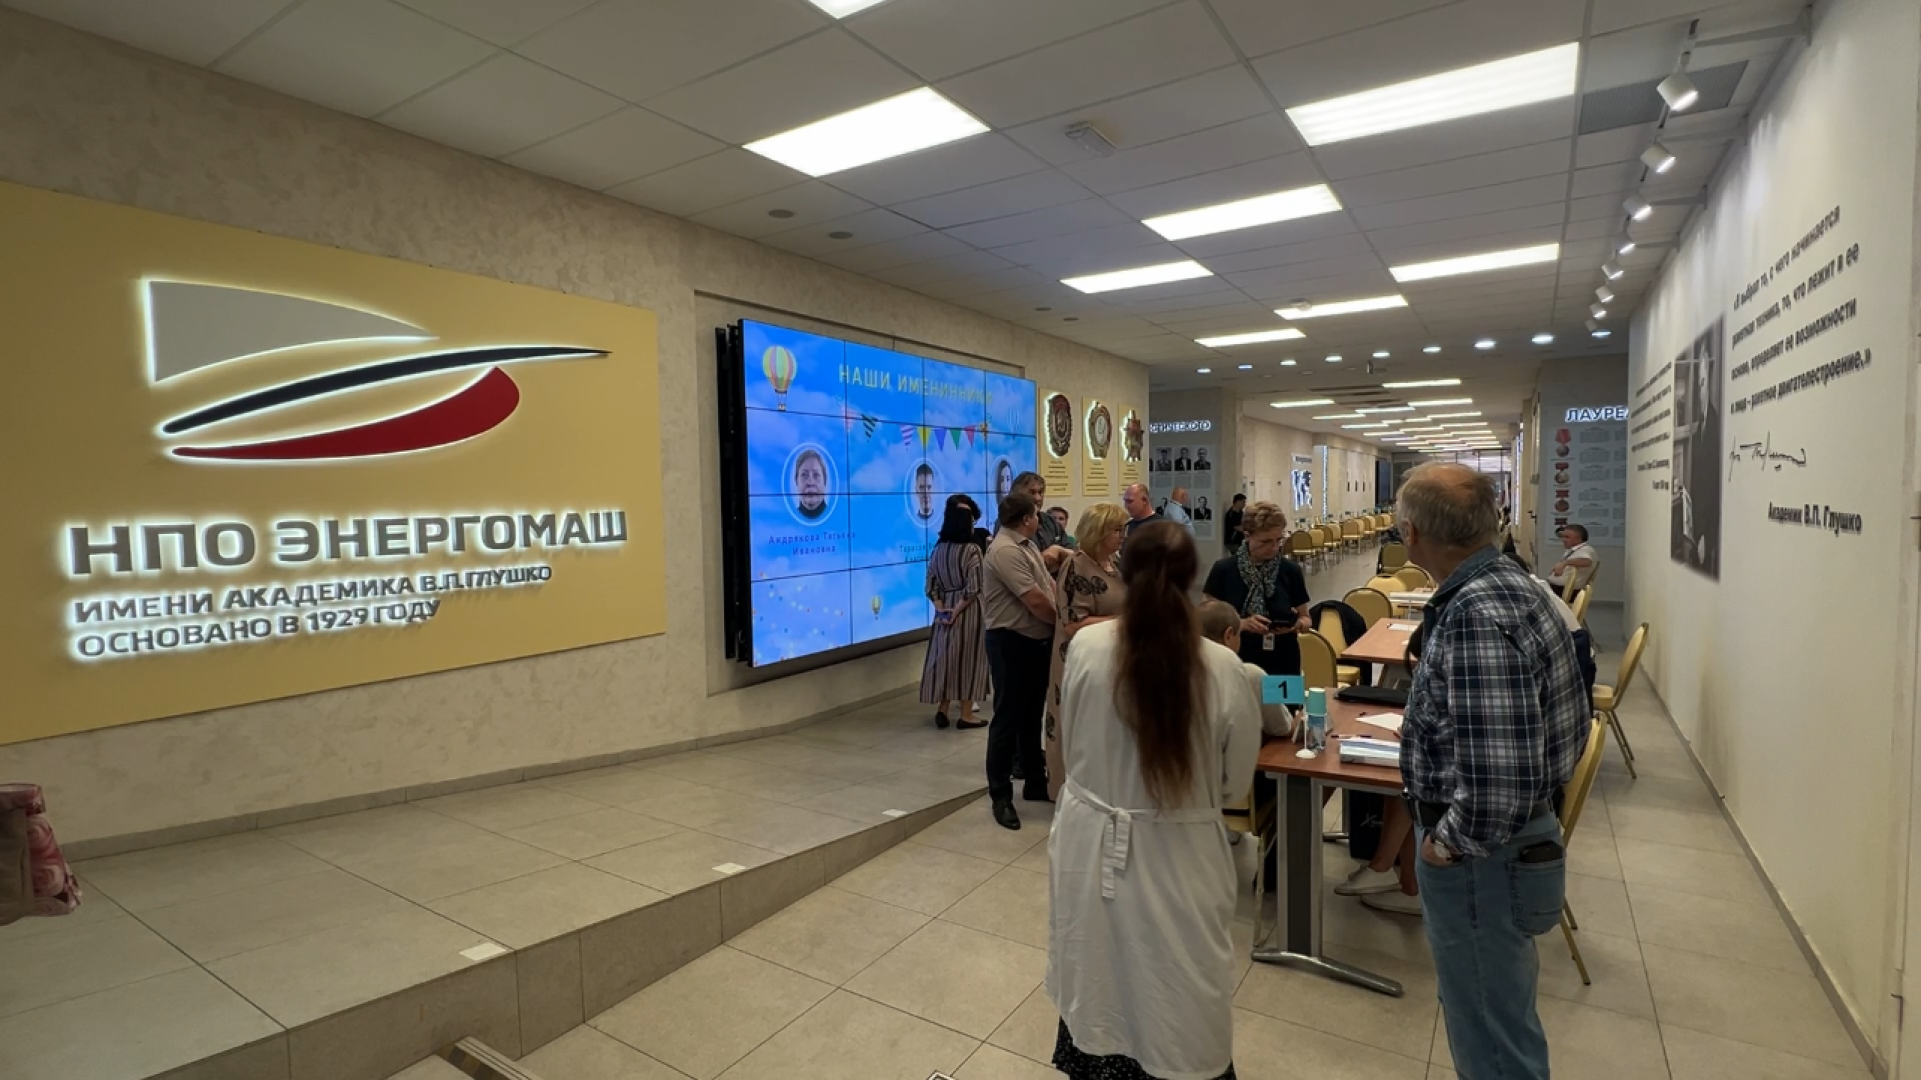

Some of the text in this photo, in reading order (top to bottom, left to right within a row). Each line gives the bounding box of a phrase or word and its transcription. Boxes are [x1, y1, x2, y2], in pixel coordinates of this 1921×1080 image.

[1769, 265, 1774, 281] с
[1775, 250, 1790, 274] чего
[1791, 204, 1841, 261] начинается
[1793, 281, 1807, 302] что
[1807, 258, 1835, 295] лежит
[1837, 253, 1844, 275] в
[1845, 242, 1860, 268] ее
[1795, 297, 1858, 347] возможности
[838, 363, 992, 406] НАШИ ИМЕНИННИКИ
[1564, 405, 1628, 423] ЛАУРЕ
[70, 510, 628, 576] НПО ЭНЕРГОМАШ
[1768, 500, 1863, 537] Академик В.П. Глушко
[792, 545, 836, 557] Ивановна
[74, 592, 214, 624] ИМЕНИ
[222, 574, 415, 610] АКАДЕМИКА
[77, 599, 442, 658] ОСНОВАНО В 1929 ГОДУ
[1277, 680, 1289, 700] 1
